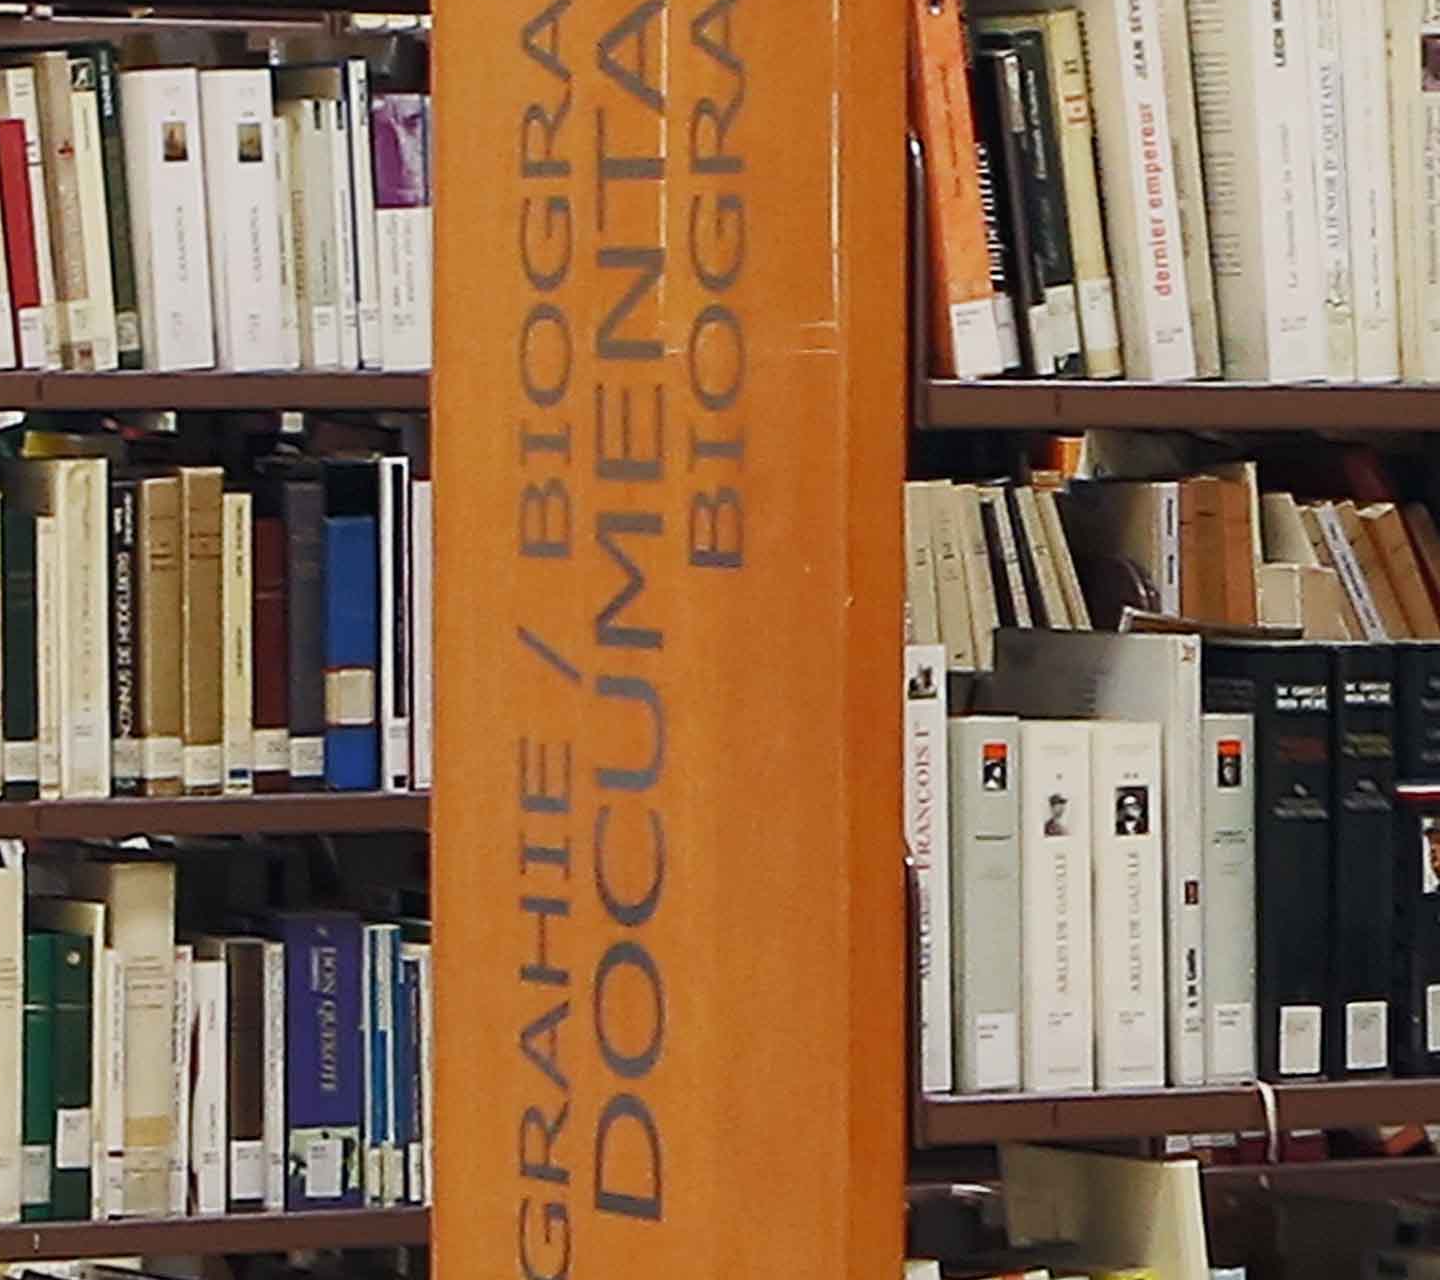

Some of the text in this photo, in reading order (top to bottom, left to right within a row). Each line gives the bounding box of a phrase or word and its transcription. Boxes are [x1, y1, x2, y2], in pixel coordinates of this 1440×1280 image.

[1131, 102, 1168, 210] empereur
[1142, 216, 1177, 298] dernier
[518, 623, 585, 684] /
